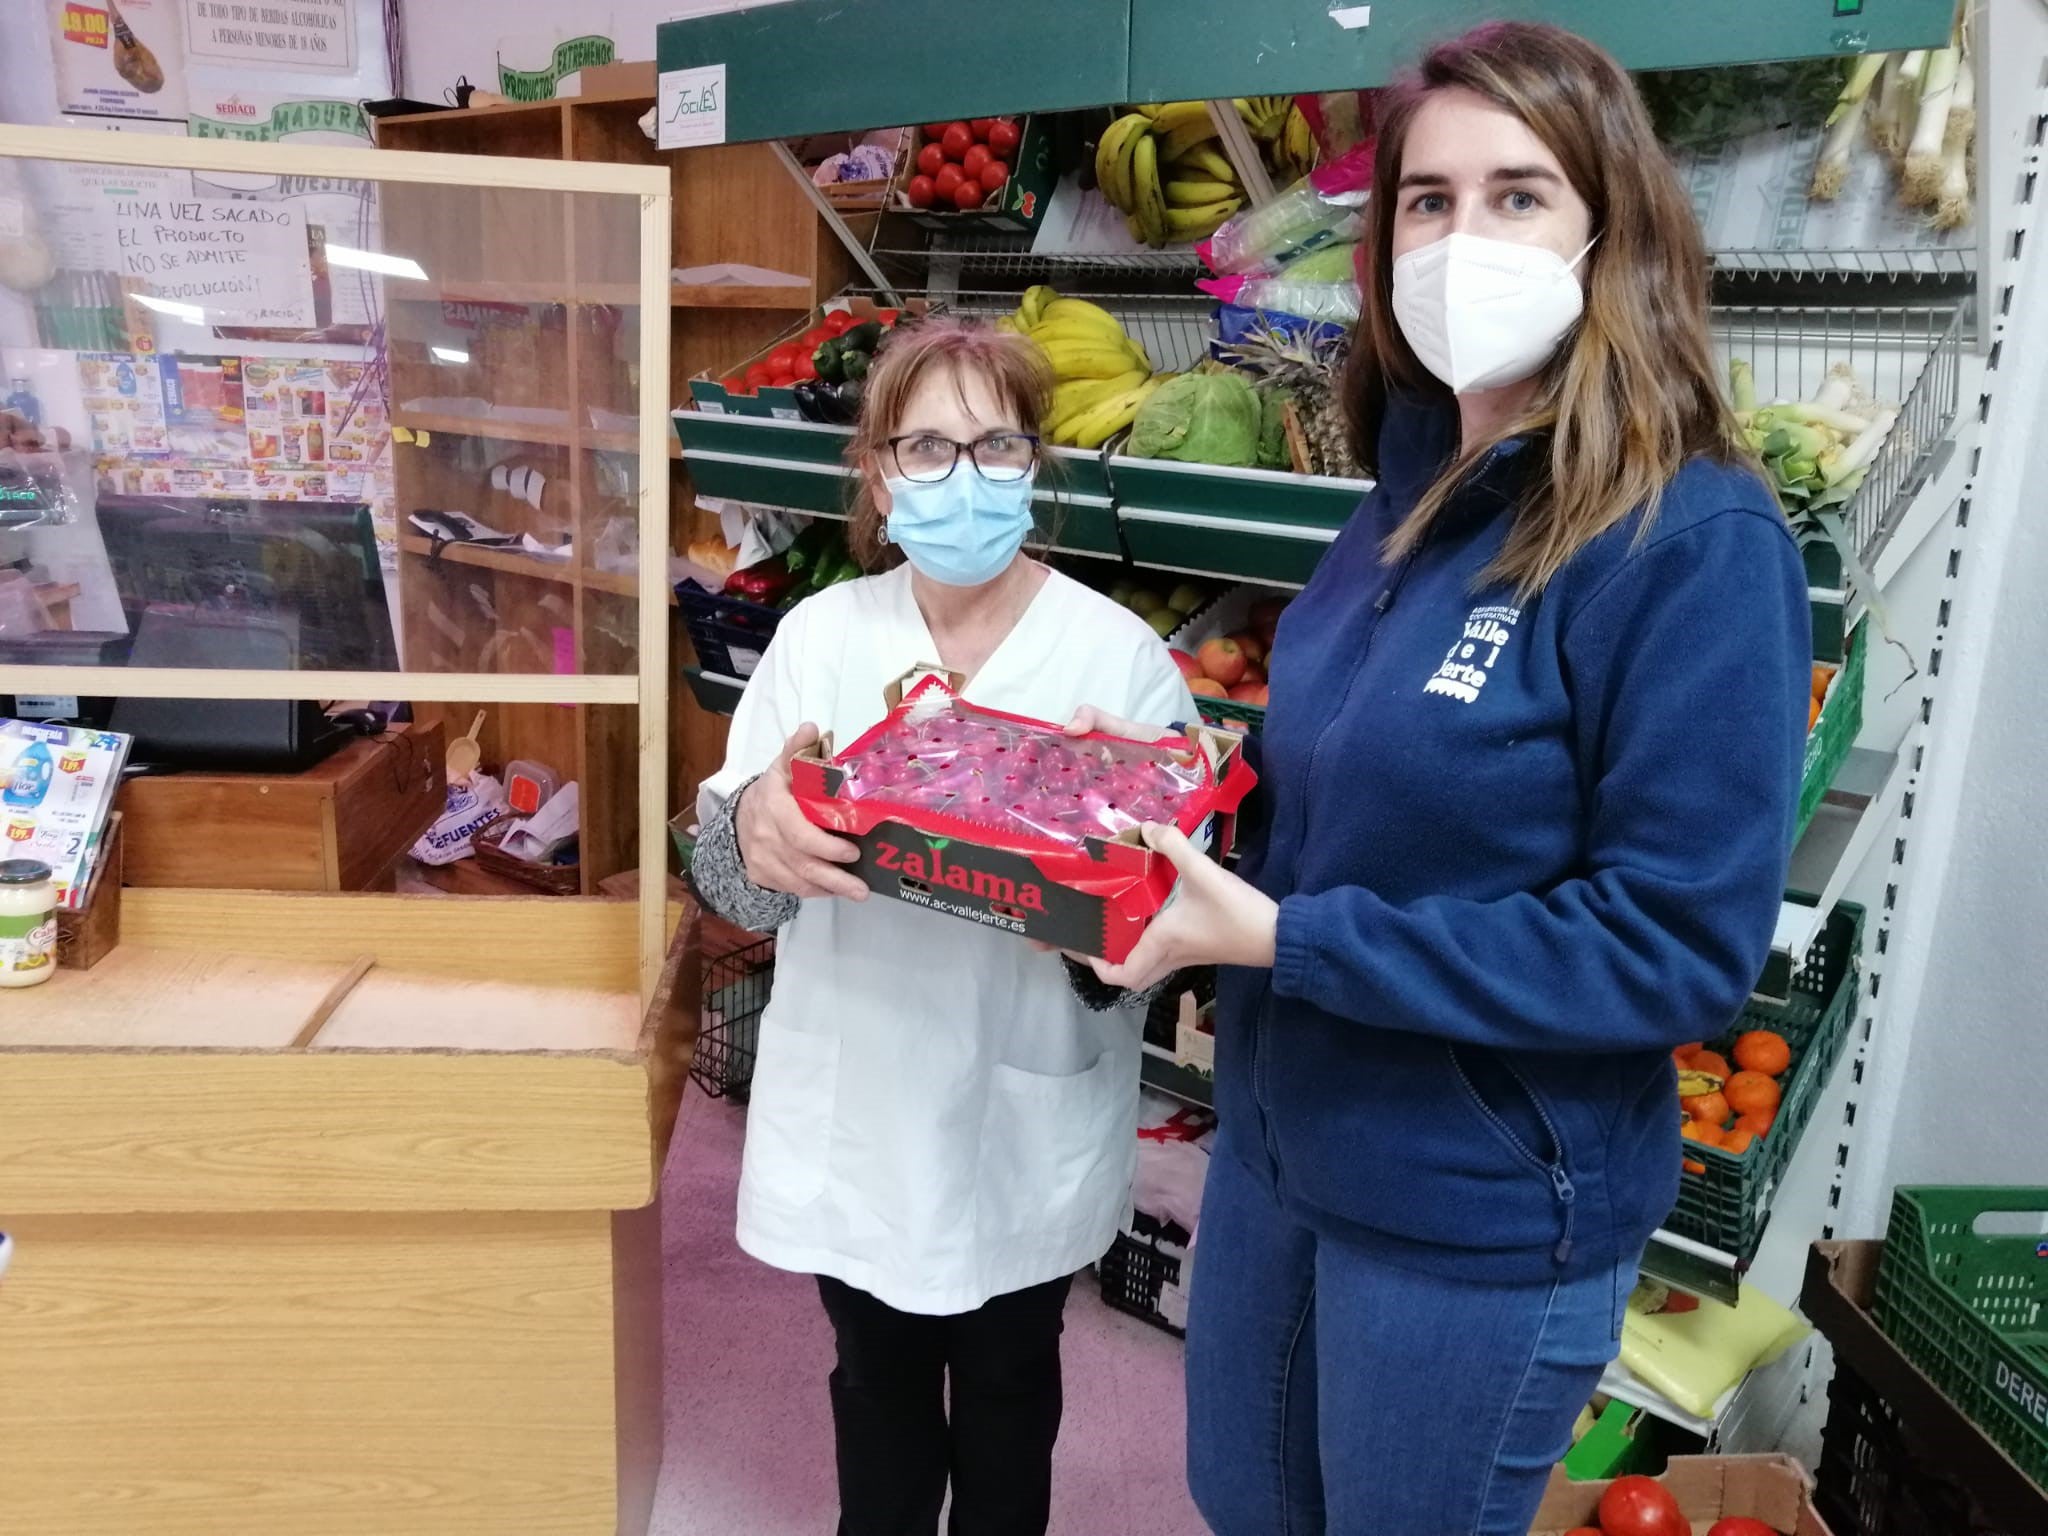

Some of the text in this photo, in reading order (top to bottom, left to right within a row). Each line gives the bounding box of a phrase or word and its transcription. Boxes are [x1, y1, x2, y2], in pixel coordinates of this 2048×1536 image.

[210, 3, 228, 19] TODO
[231, 5, 247, 21] TIPO
[261, 8, 288, 25] BEBIDAS
[219, 28, 253, 46] PERSONAS
[255, 32, 286, 49] MENORES
[502, 70, 556, 103] PRODUCTOS
[170, 203, 204, 222] VEZ
[212, 208, 290, 227] SACADO
[118, 225, 244, 247] EL PRODUCTO
[128, 249, 249, 274] NO SE ADMITE
[1463, 620, 1509, 646] Valle
[875, 841, 1049, 915] zalama
[899, 888, 1027, 933] www.ac-vallejerte.es
